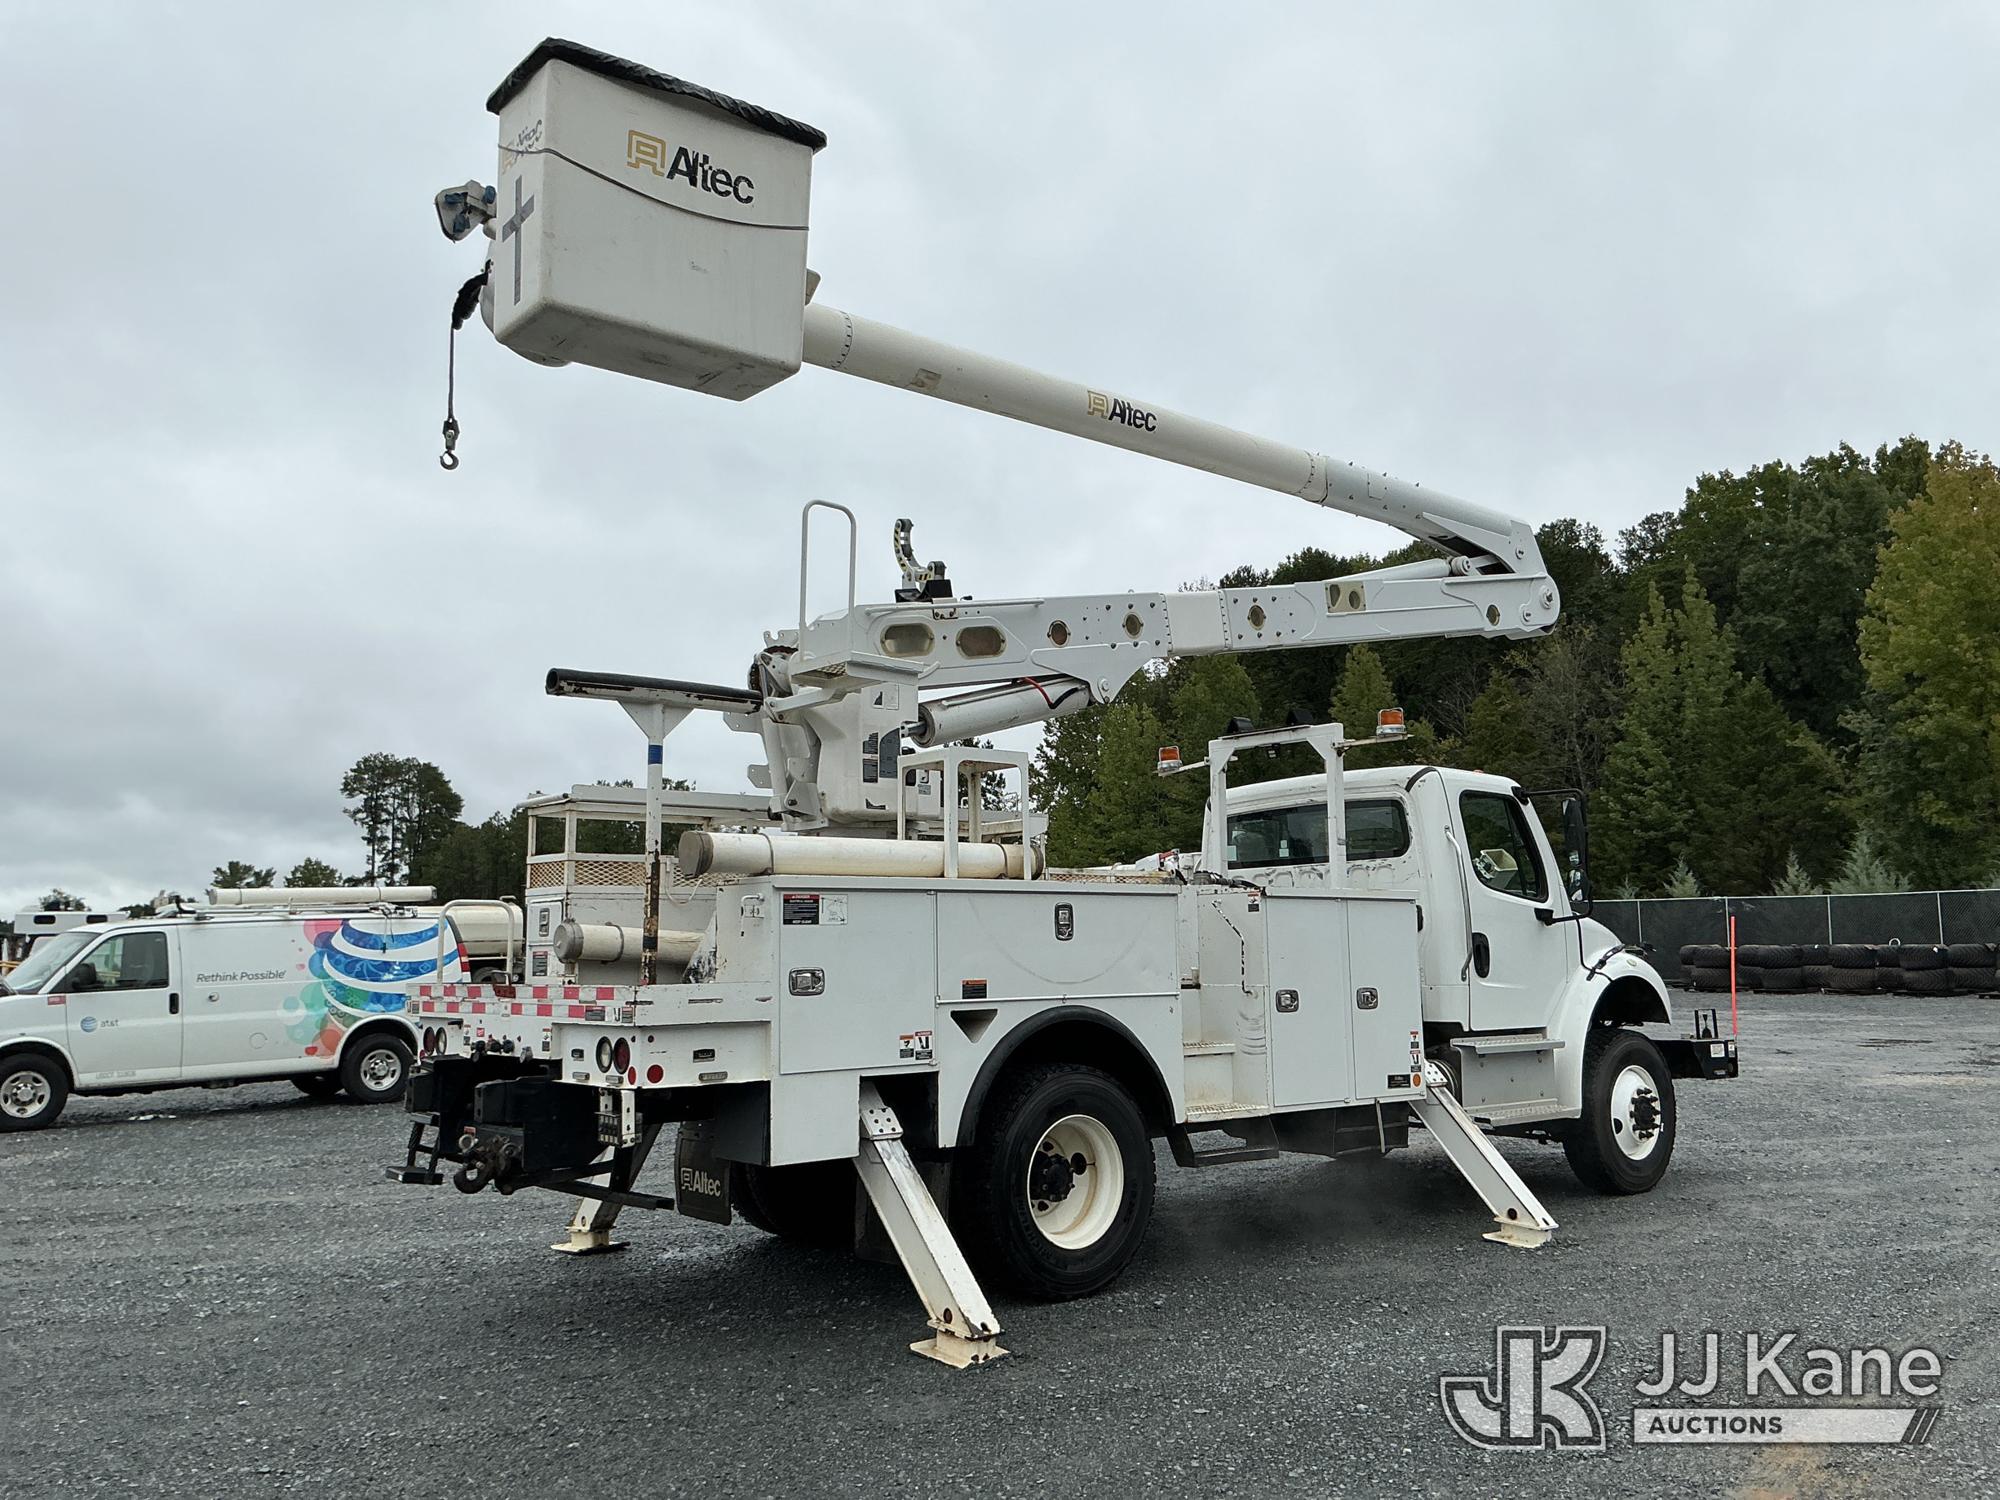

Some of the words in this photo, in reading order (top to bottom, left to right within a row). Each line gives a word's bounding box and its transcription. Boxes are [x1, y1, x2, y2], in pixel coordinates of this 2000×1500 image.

[666, 146, 755, 204] Altec
[1108, 398, 1157, 432] Altec
[196, 972, 238, 982] Rethink
[240, 970, 284, 981] Possible
[692, 1170, 721, 1197] Altec
